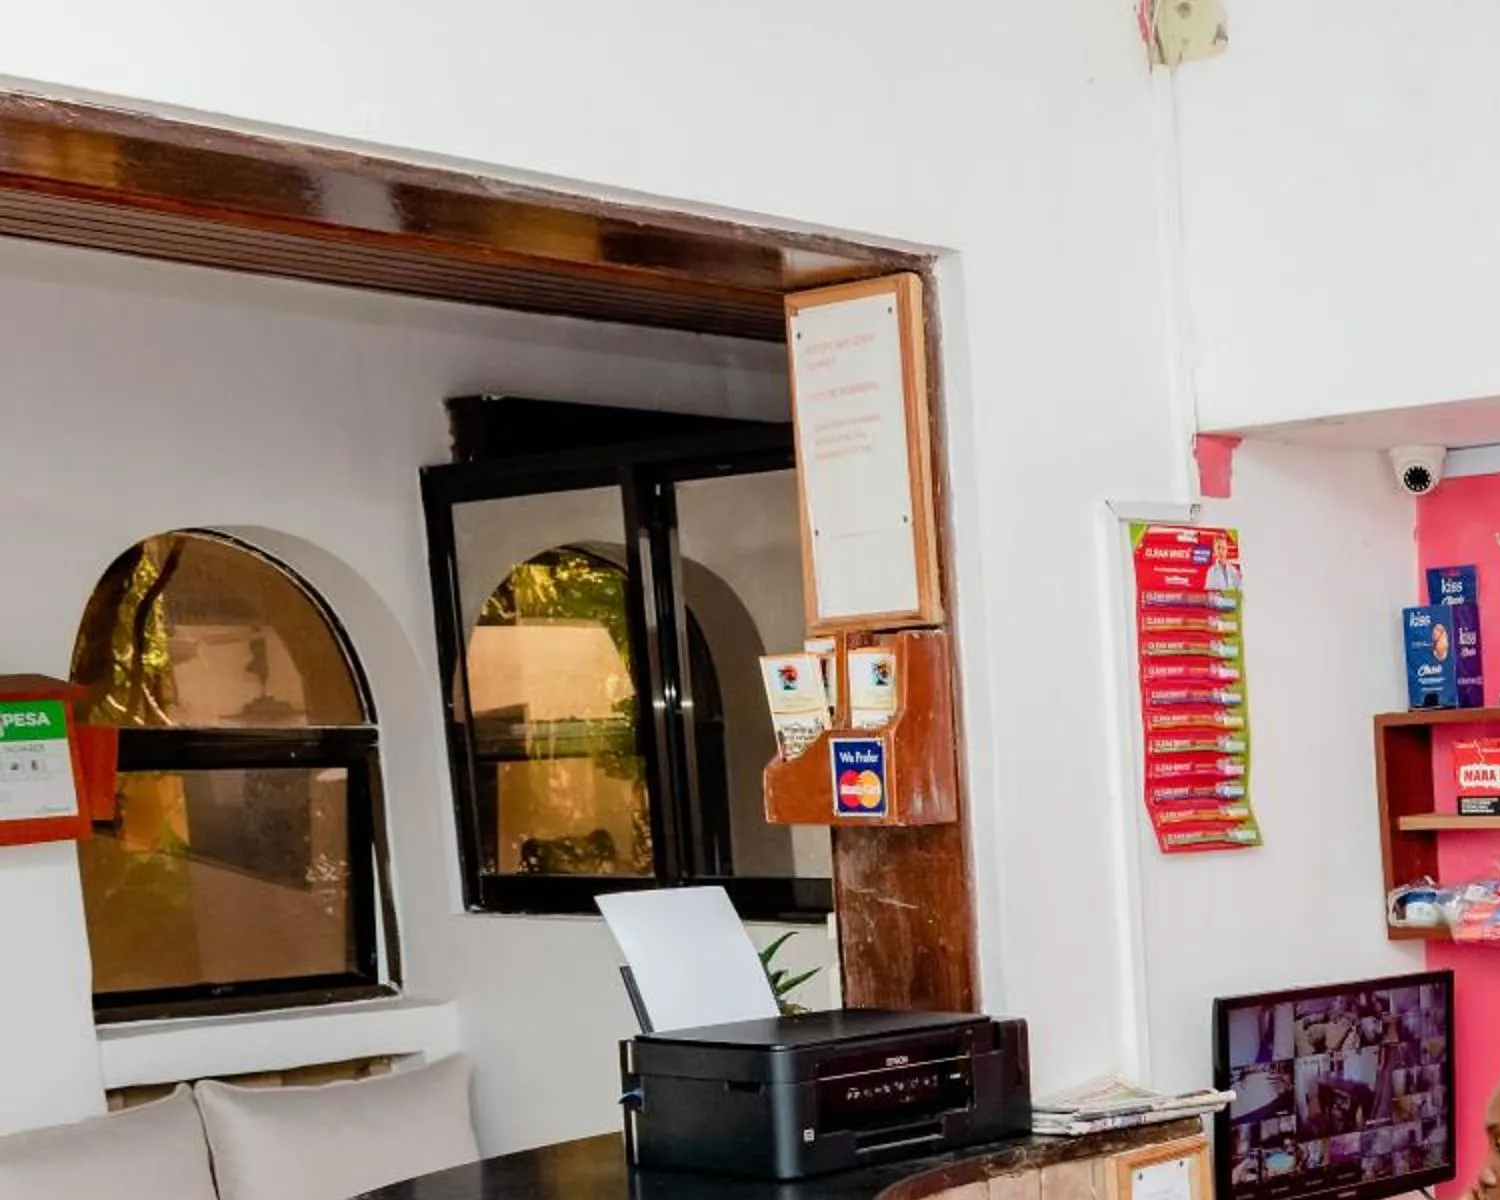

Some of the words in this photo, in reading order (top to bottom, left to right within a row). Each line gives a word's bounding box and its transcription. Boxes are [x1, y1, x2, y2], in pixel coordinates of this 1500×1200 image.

[1441, 577, 1463, 595] kiss
[1409, 609, 1432, 627] kiss
[1458, 628, 1477, 646] kiss
[2, 711, 52, 728] PESA
[839, 751, 855, 764] We
[855, 749, 879, 764] Prefer
[1463, 768, 1497, 782] MARA
